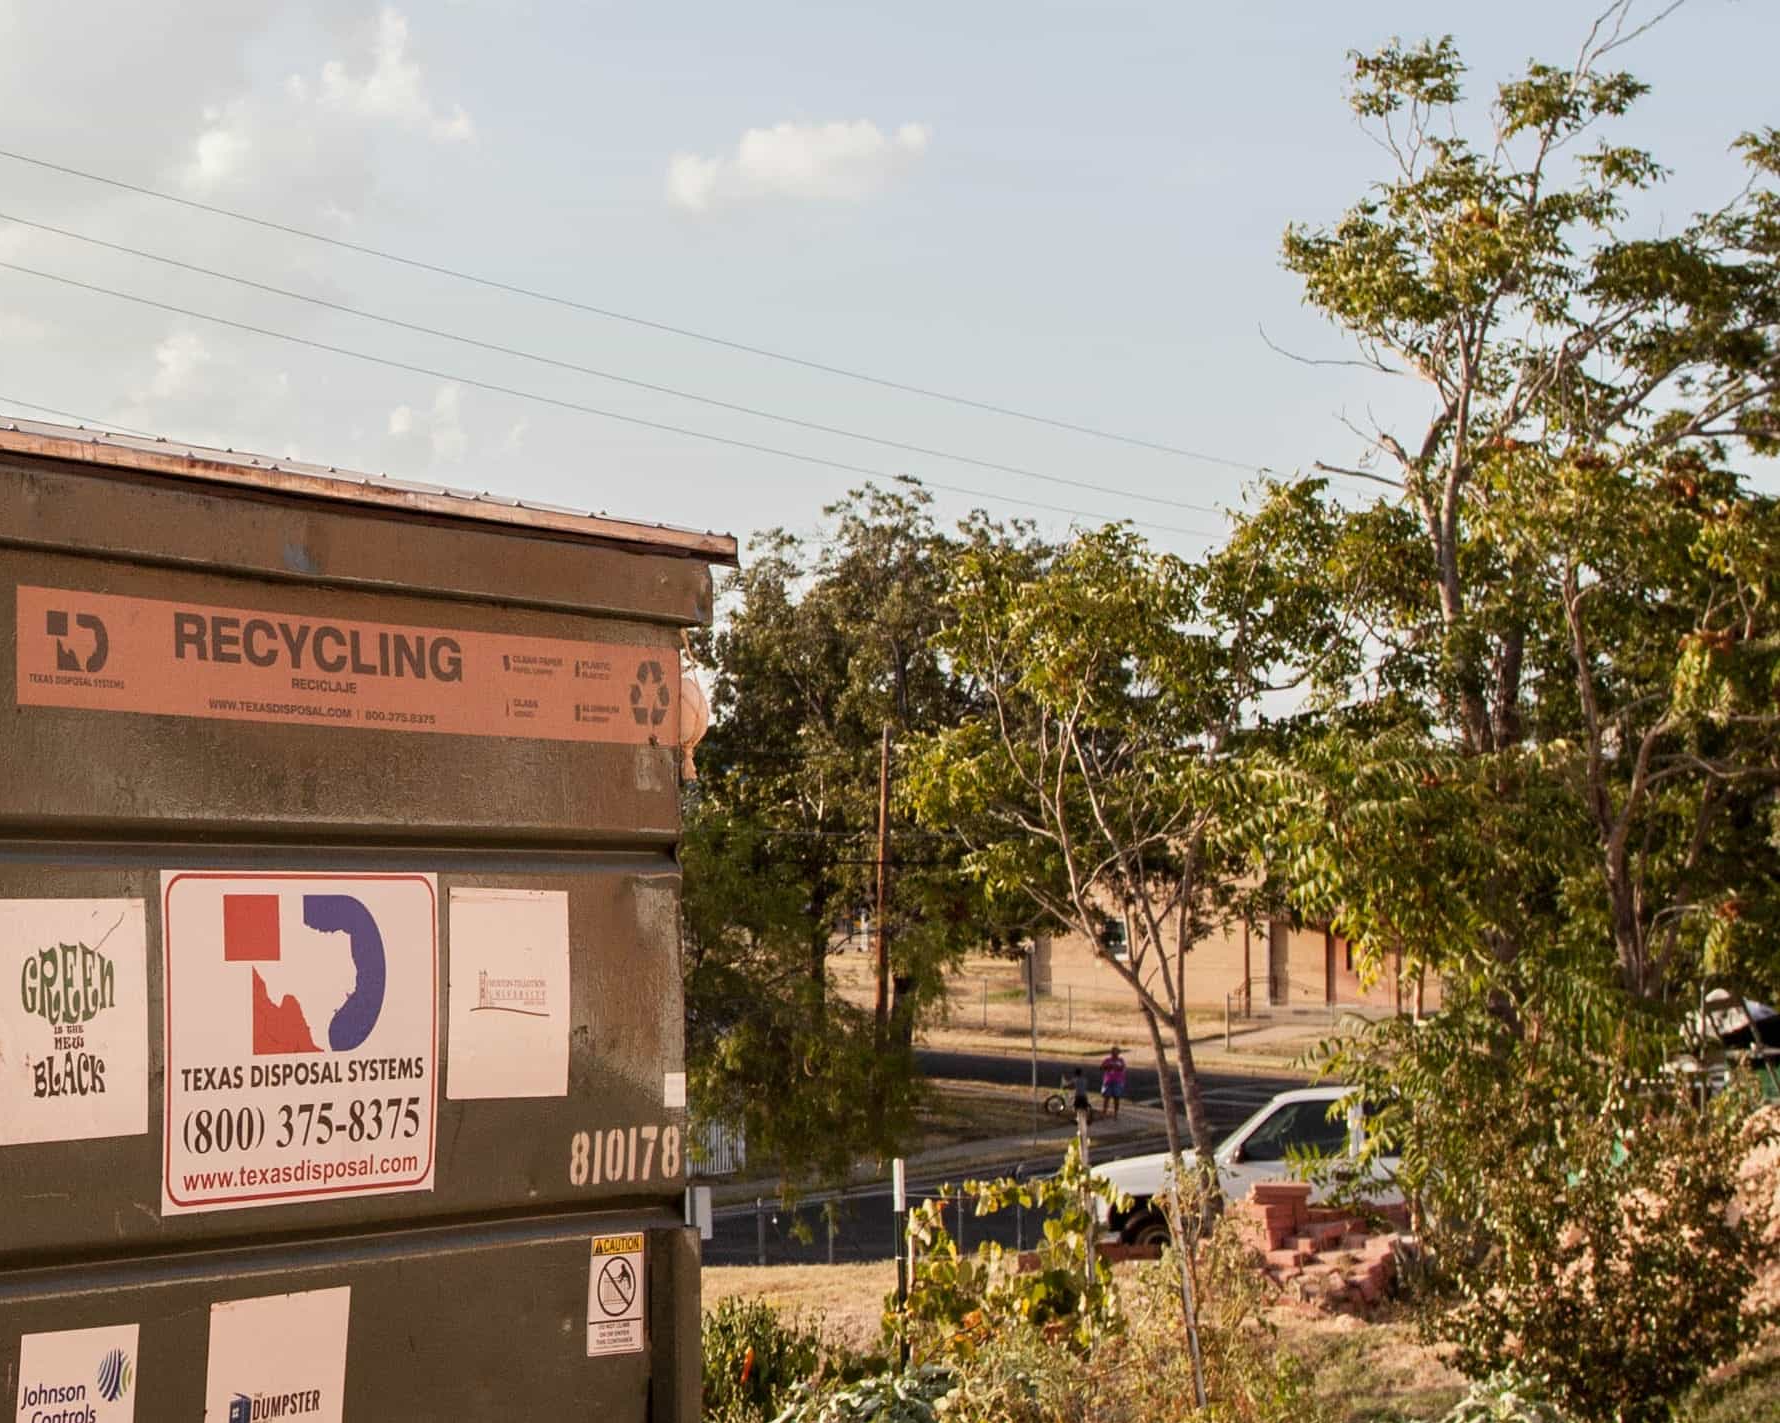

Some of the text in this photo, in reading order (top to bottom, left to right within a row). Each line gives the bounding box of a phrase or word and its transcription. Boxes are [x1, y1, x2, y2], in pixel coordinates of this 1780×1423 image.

[173, 612, 463, 682] RECYCLING
[28, 673, 125, 690] TEXAS DISPOSAL SYSTEMS
[291, 678, 357, 695] RECICLAJE
[208, 698, 436, 725] WWW.TEXASDISPOSAL.COM 800.375.8375
[20, 940, 116, 1026] GREEN
[53, 1024, 85, 1036] IS THE
[54, 1035, 85, 1051] NEW
[33, 1051, 106, 1098] BLACK
[181, 1057, 425, 1092] TEXAS DISPOSAL SYSTEMS
[183, 1096, 421, 1154] (800) 375-8375
[570, 1124, 681, 1186] 810178
[183, 1154, 419, 1192] www.texasdisposal.com
[603, 1238, 639, 1252] CAUTION
[20, 1383, 86, 1410] Johnson
[252, 1389, 321, 1421] DUMPSTER
